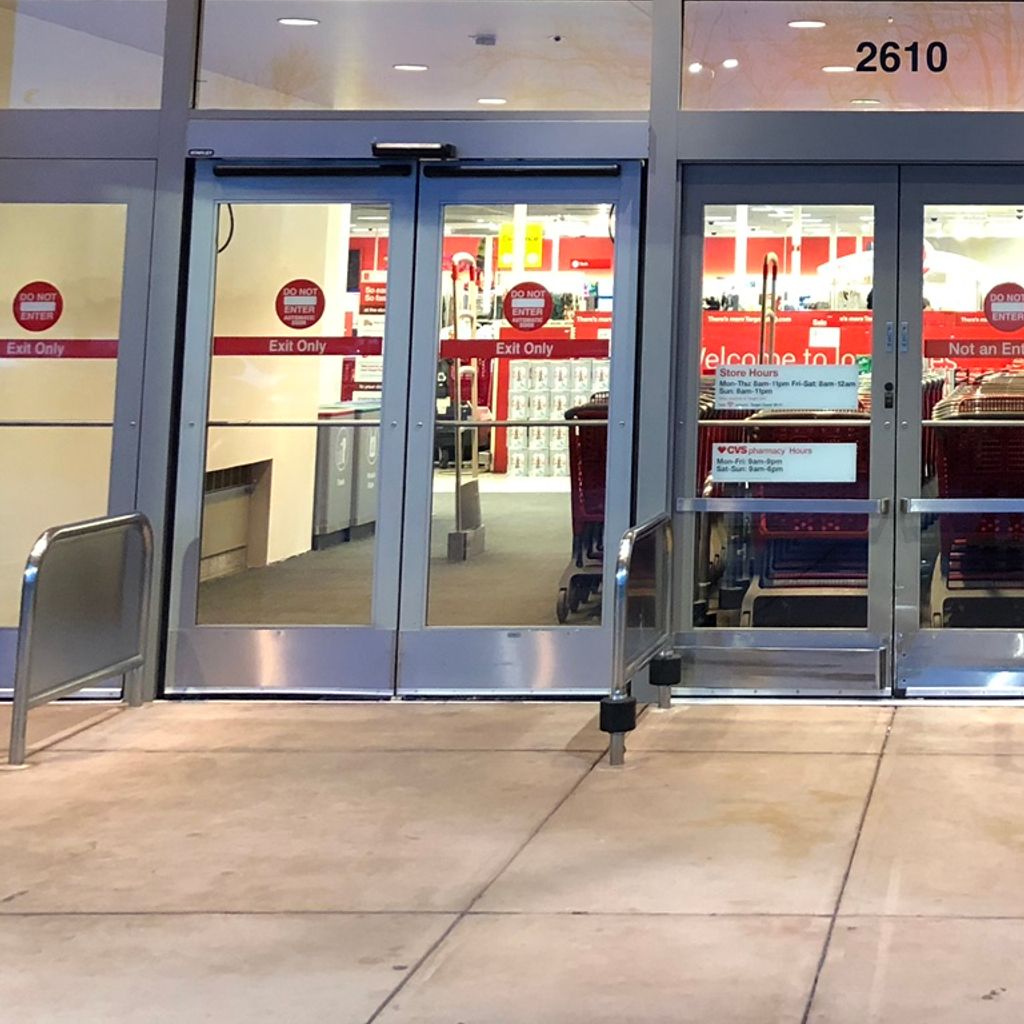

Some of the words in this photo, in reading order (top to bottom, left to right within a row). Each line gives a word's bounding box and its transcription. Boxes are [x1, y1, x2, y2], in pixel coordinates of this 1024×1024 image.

[856, 42, 947, 73] 2610
[283, 287, 297, 296] DO
[299, 288, 318, 296] NOT
[511, 290, 525, 298] DO
[527, 290, 545, 298] NOT
[20, 293, 34, 302] DO
[37, 293, 57, 302] NOT
[990, 293, 1005, 302] DO
[284, 306, 316, 314] ENTER
[512, 308, 543, 316] ENTER
[21, 312, 54, 321] ENTER
[992, 312, 1024, 321] ENTER
[7, 342, 31, 355] Exit
[35, 342, 64, 357] Only
[269, 340, 293, 352] Exit
[297, 339, 327, 355] Only
[496, 342, 520, 355] Exit
[524, 342, 554, 357] Only
[949, 342, 975, 356] Not
[980, 345, 997, 356] an
[803, 348, 827, 366] to
[719, 368, 746, 377] Store
[749, 368, 779, 377] Hours
[727, 445, 747, 454] CVS
[748, 447, 785, 456] pharmacy
